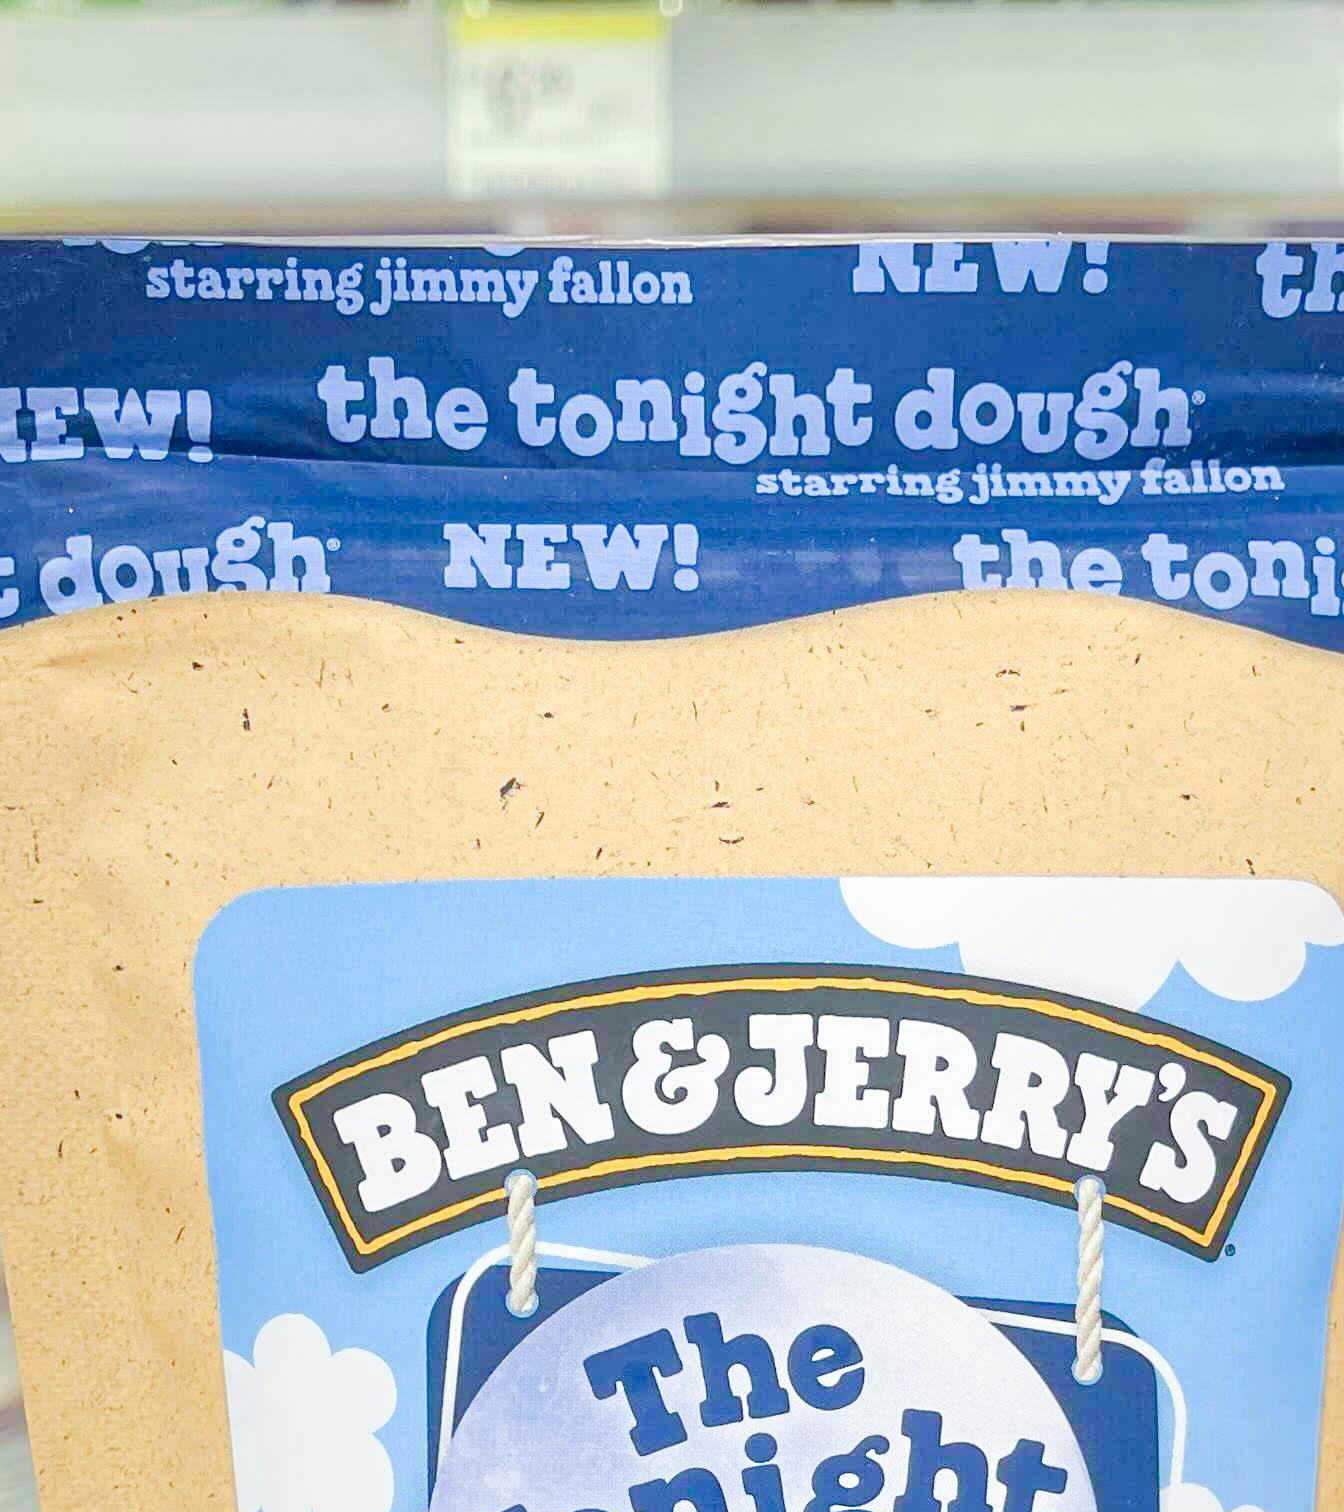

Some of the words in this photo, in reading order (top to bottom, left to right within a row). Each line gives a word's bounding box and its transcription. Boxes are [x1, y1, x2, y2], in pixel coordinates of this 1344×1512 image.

[145, 257, 365, 316] starring
[370, 257, 538, 317] jimmy
[548, 257, 693, 305] fallon
[852, 240, 1110, 294] NEW!
[318, 356, 489, 451] the
[509, 361, 872, 465] tonight
[756, 465, 962, 505] starring
[967, 462, 1134, 506] jimmy
[1141, 458, 1284, 497] fallon
[442, 522, 700, 592] NEW!
[953, 528, 1122, 595] the
[583, 1311, 865, 1457] The
